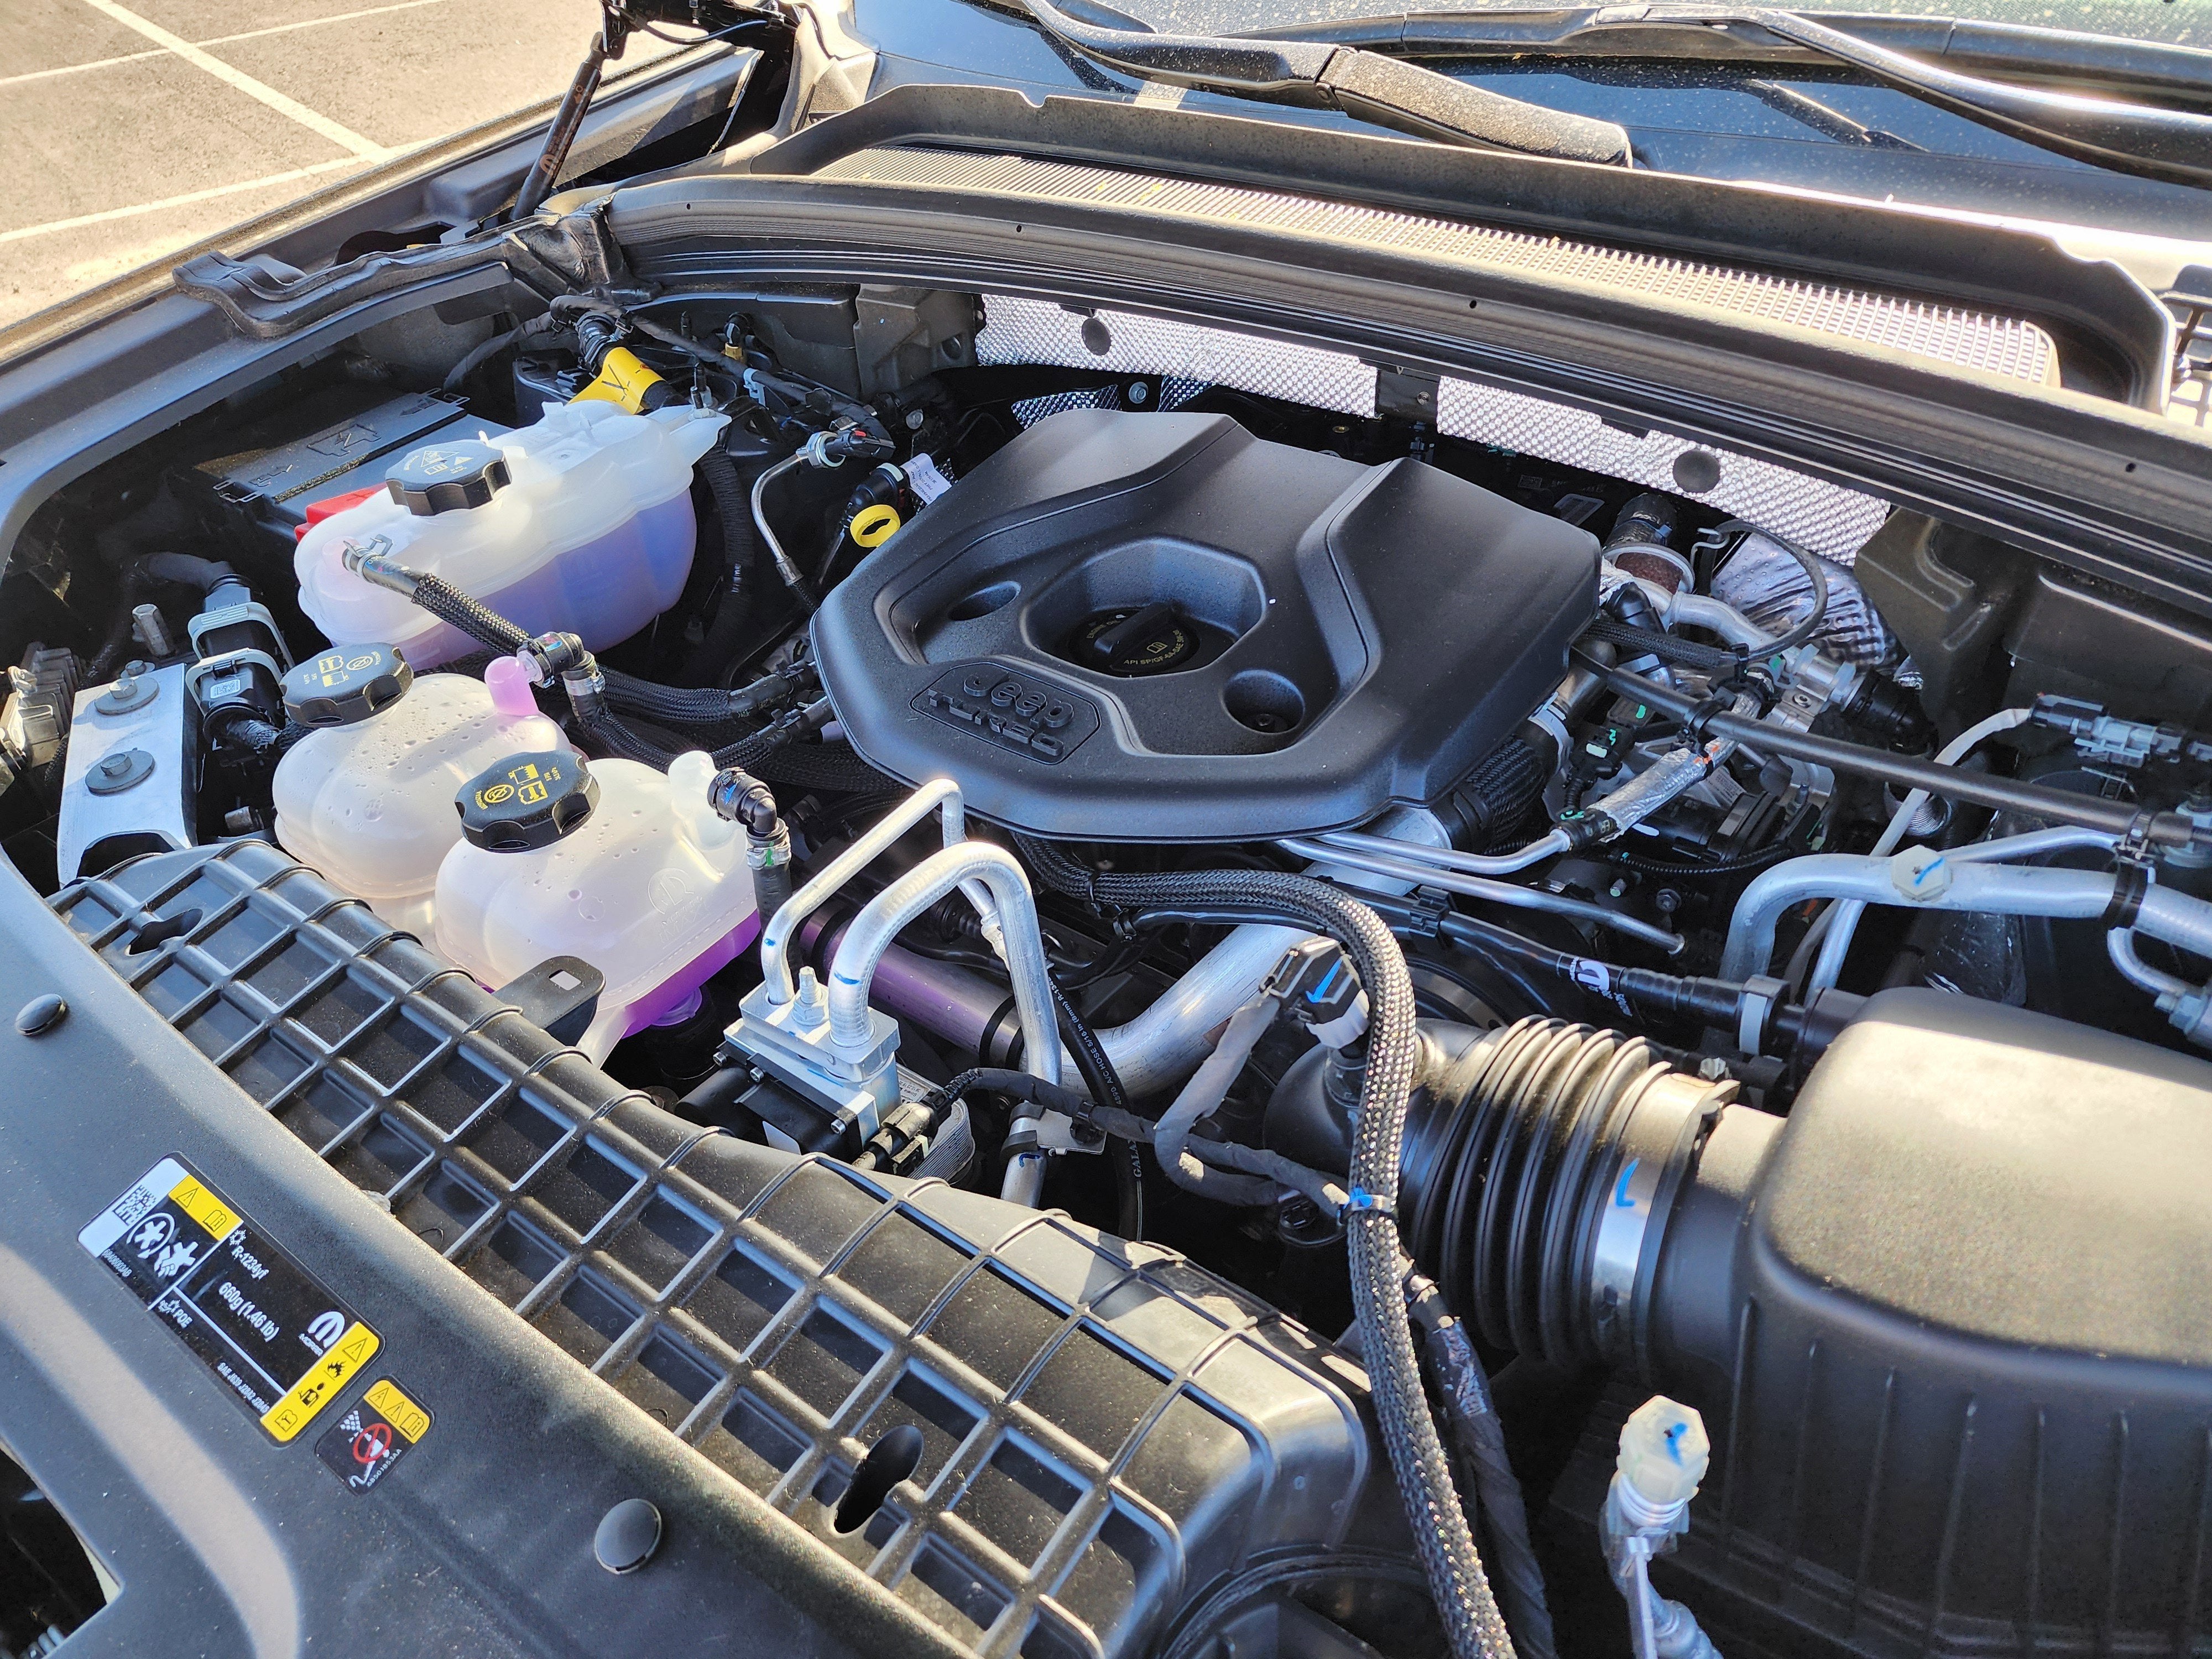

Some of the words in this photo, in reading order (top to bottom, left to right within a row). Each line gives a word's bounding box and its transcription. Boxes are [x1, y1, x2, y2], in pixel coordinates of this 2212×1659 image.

[963, 670, 1074, 729] Jeep
[927, 689, 1065, 757] TURBO
[1062, 1001, 1080, 1024] (8mm)
[1081, 1031, 1094, 1048] 5/16
[1091, 1047, 1106, 1070] HOSE
[1102, 1071, 1114, 1084] A/C
[231, 1245, 269, 1281] R-1234yf
[173, 1309, 192, 1328] POE
[218, 1282, 244, 1311] 660g
[237, 1301, 267, 1328] (1.46
[260, 1320, 279, 1342] lb)
[298, 1333, 323, 1357] MOPAR
[217, 1362, 232, 1376] SAE
[227, 1373, 242, 1387] J639
